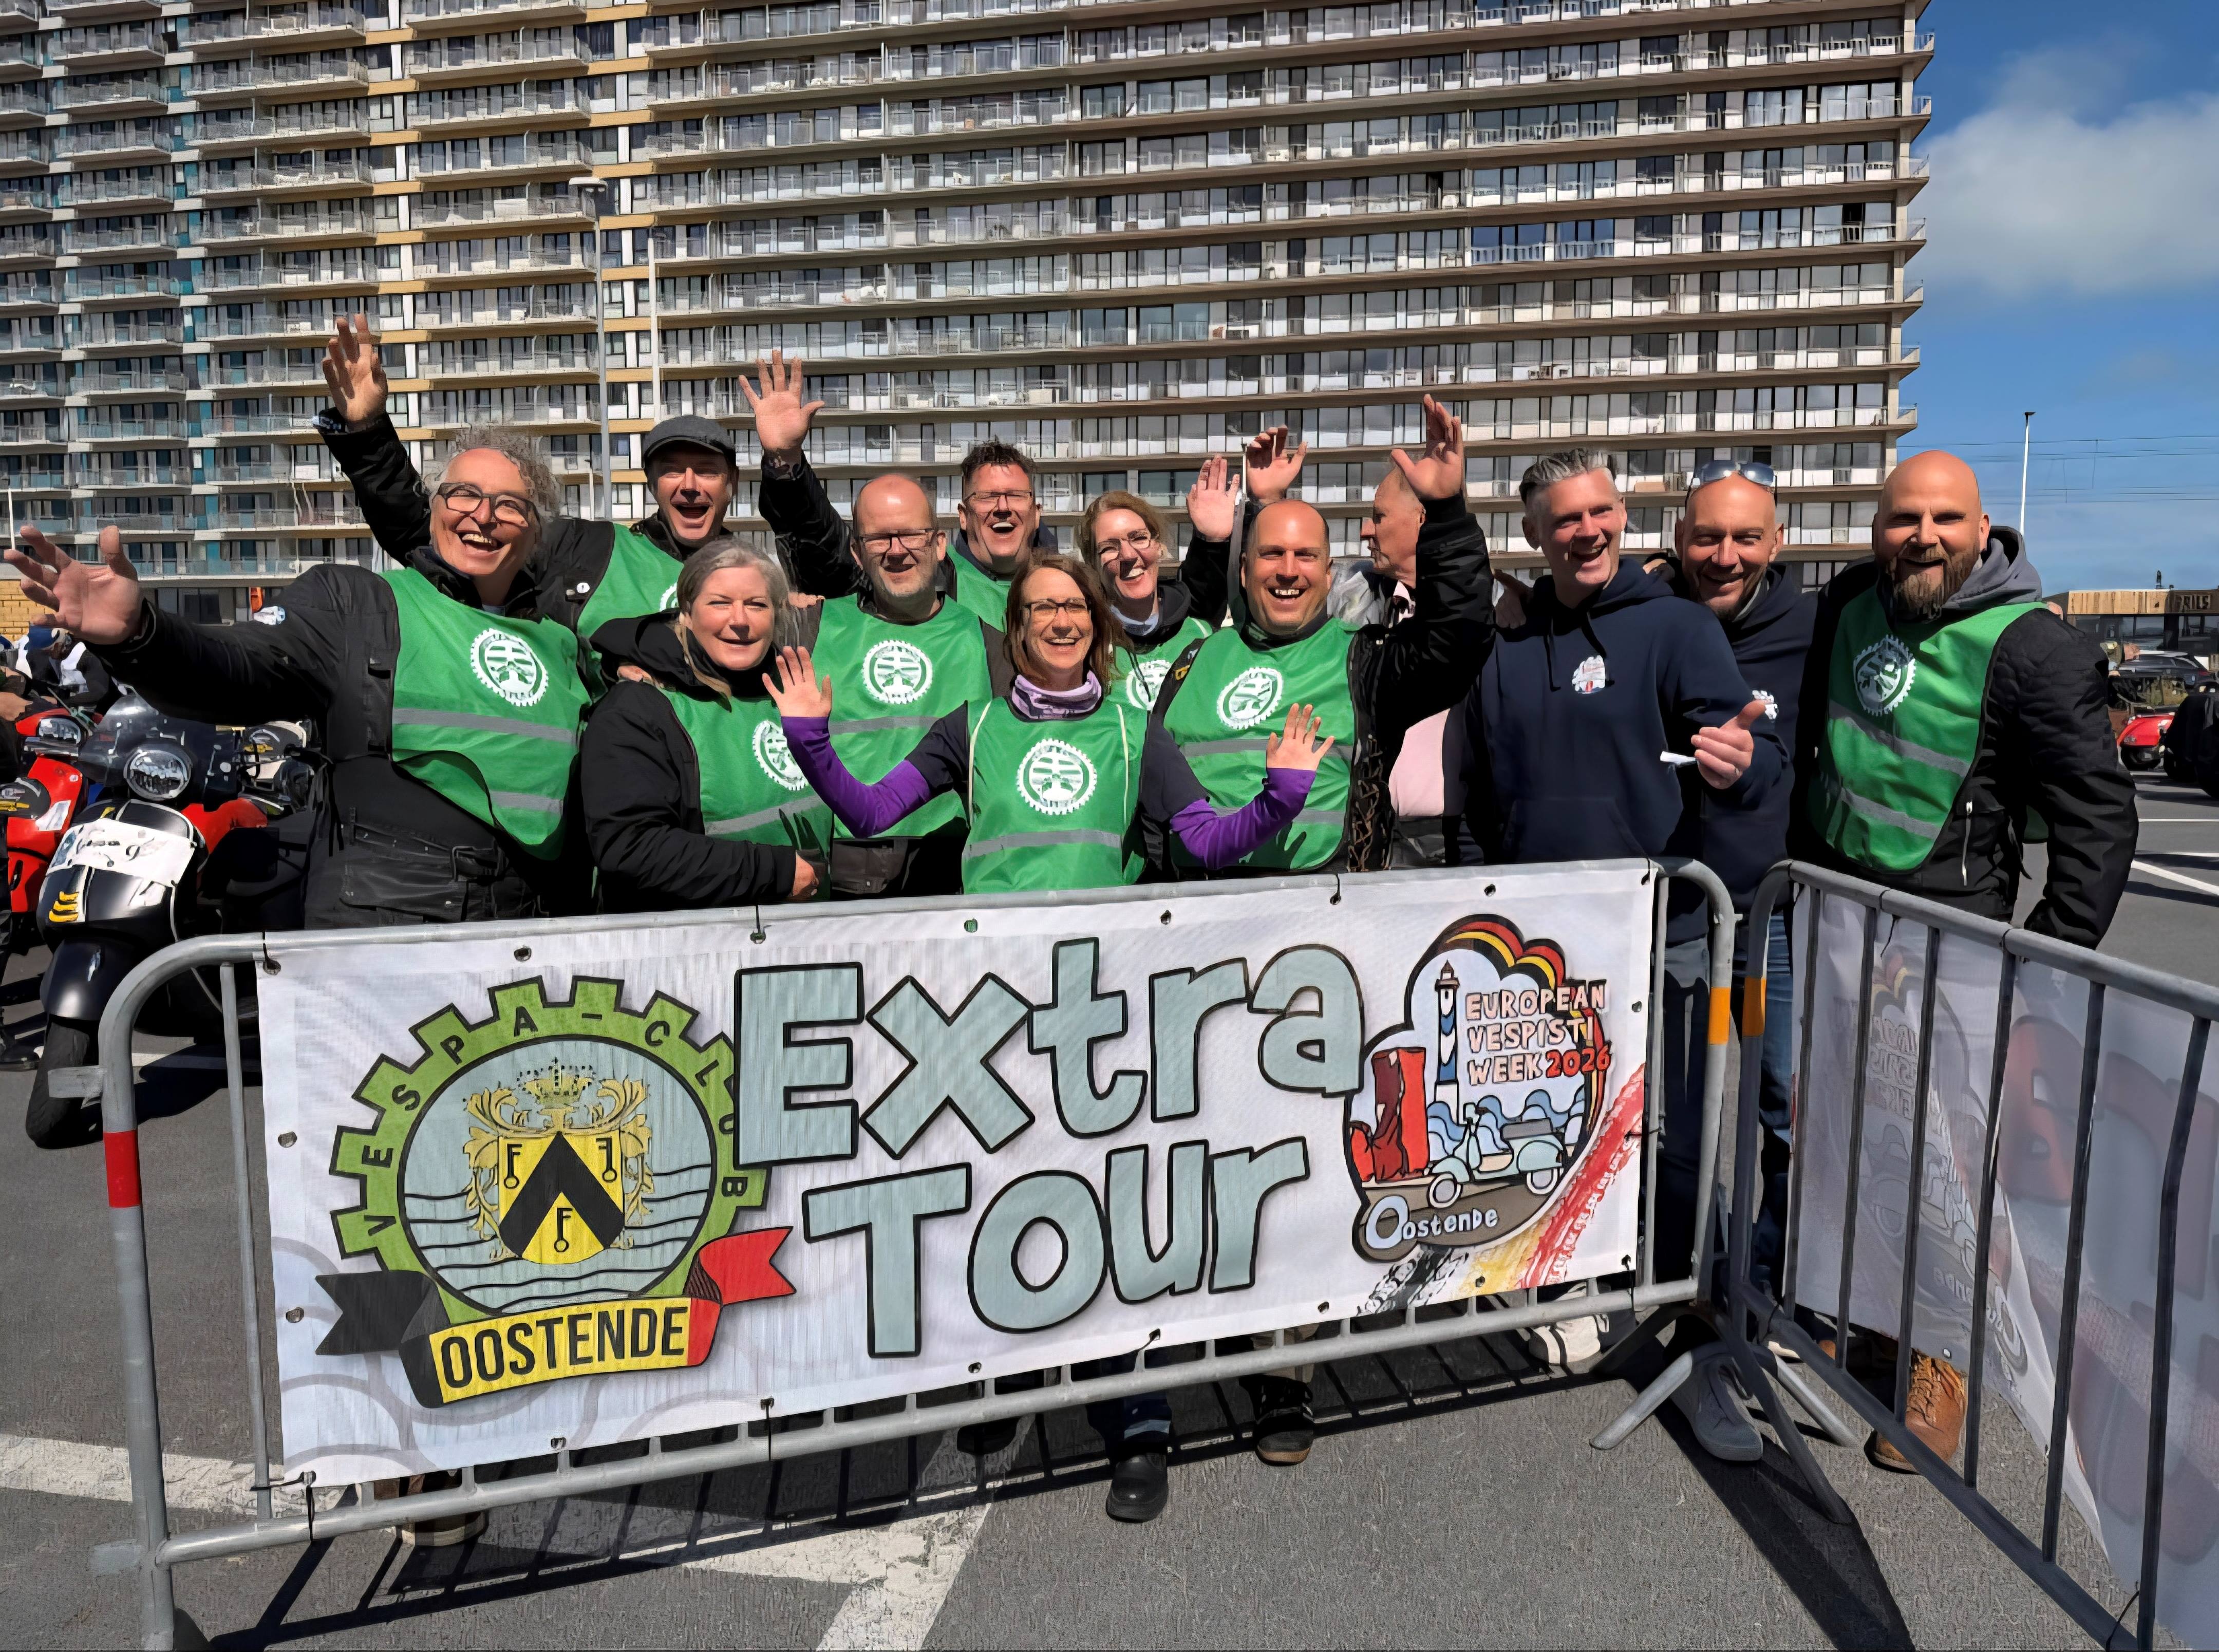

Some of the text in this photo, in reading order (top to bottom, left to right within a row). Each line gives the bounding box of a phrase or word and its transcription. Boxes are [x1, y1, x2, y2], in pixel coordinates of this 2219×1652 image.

[1465, 981, 1606, 1021] EUROPEAN
[734, 937, 1364, 1170] Extra
[1468, 1016, 1593, 1053] VESPISTI
[1468, 1043, 1611, 1086] WEEK 2026
[802, 1137, 1310, 1359] Tour
[441, 1307, 687, 1388] OOSTENDE
